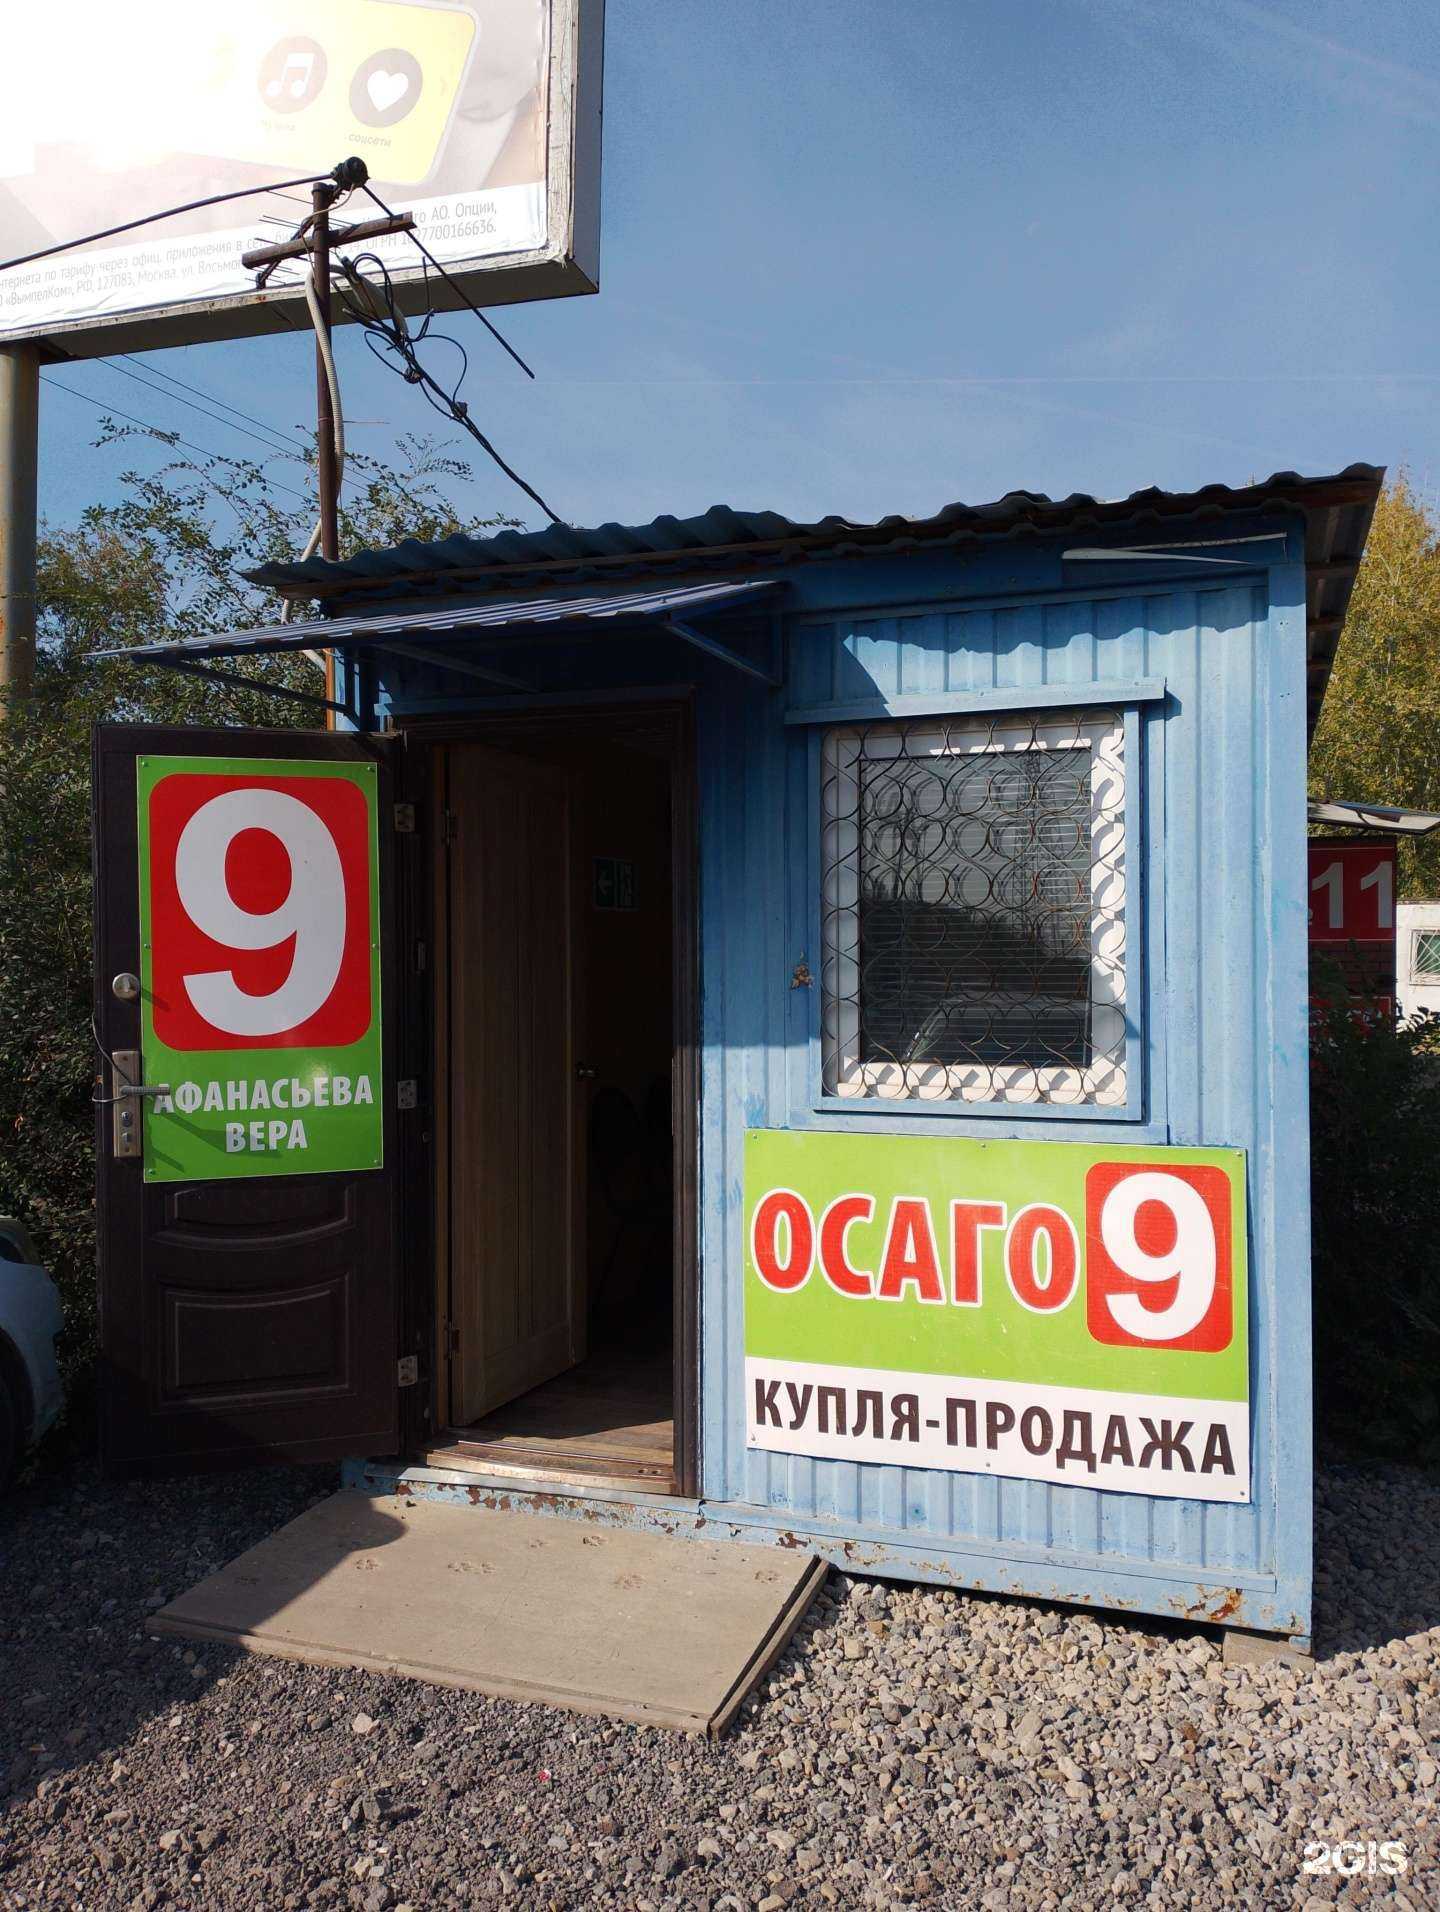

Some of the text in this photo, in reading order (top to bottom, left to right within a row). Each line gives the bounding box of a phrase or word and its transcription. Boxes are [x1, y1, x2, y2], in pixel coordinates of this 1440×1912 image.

[431, 205, 450, 221] АО.
[455, 201, 497, 218] Опции,
[45, 270, 57, 282] по
[175, 788, 347, 1036] 9
[1312, 861, 1393, 929] 11
[153, 1074, 374, 1115] АФАНАСЬЕВА
[225, 1118, 308, 1153] ВЕРА
[750, 1172, 1217, 1340] ОСАГО 9
[754, 1378, 1237, 1476] КУПЛЯ-ПРОДАЖА
